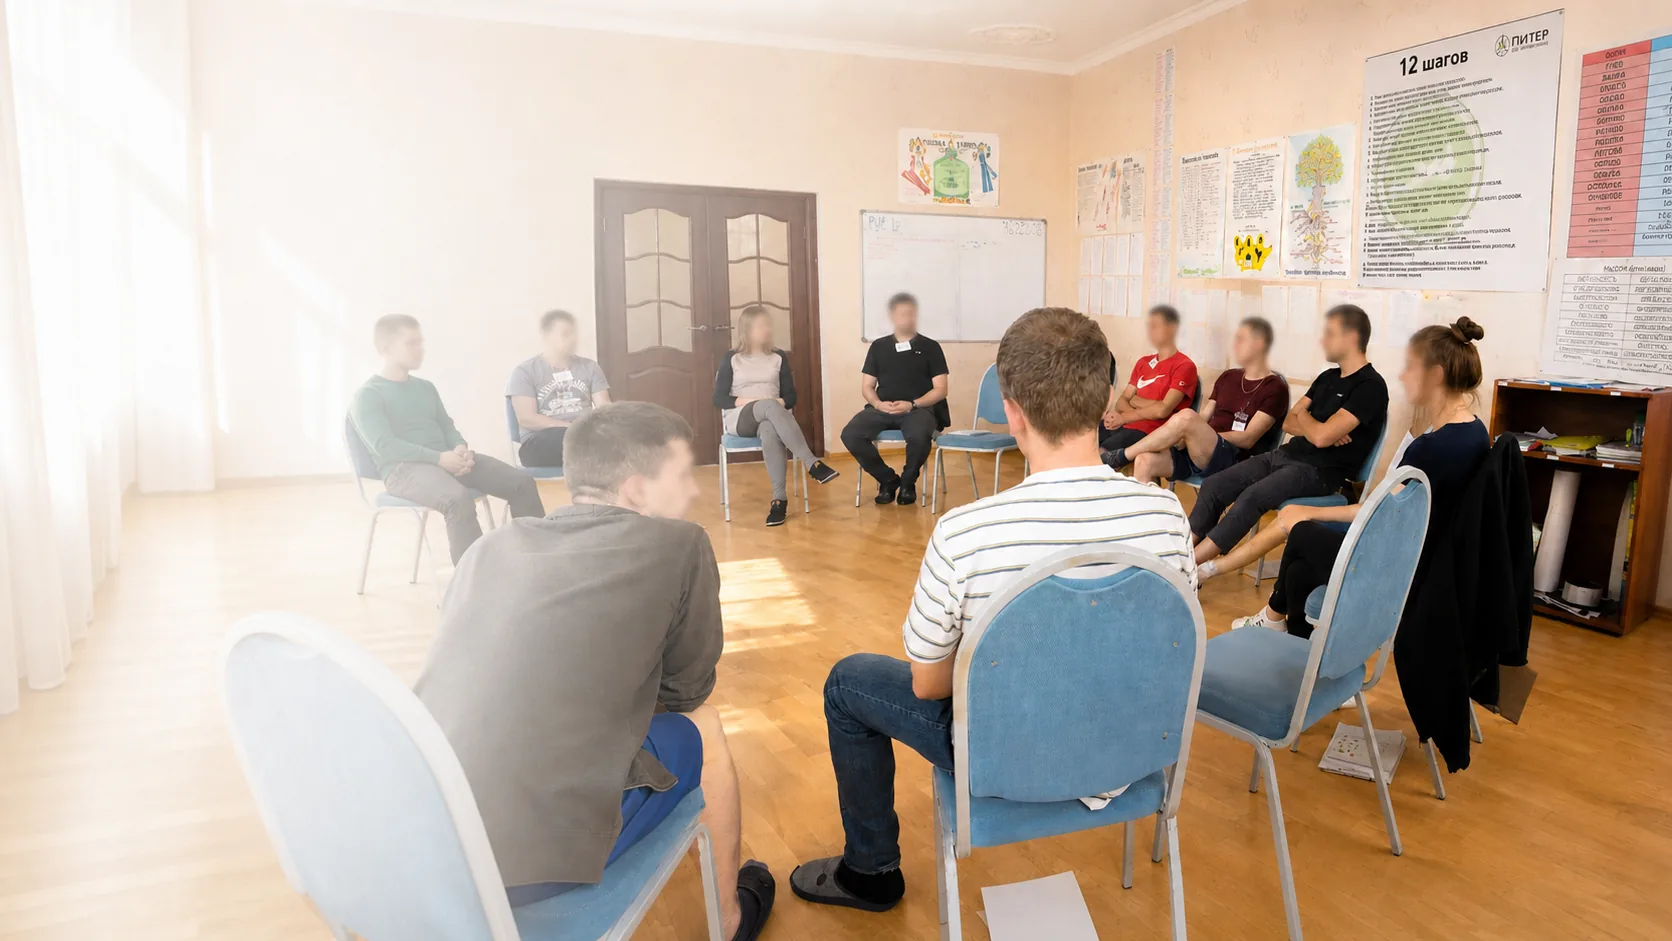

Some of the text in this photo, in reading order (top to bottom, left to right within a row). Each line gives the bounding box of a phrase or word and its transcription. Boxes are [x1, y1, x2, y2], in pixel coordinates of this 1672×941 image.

[1511, 29, 1549, 47] ПИТЕР
[1400, 51, 1468, 76] 12 шагов
